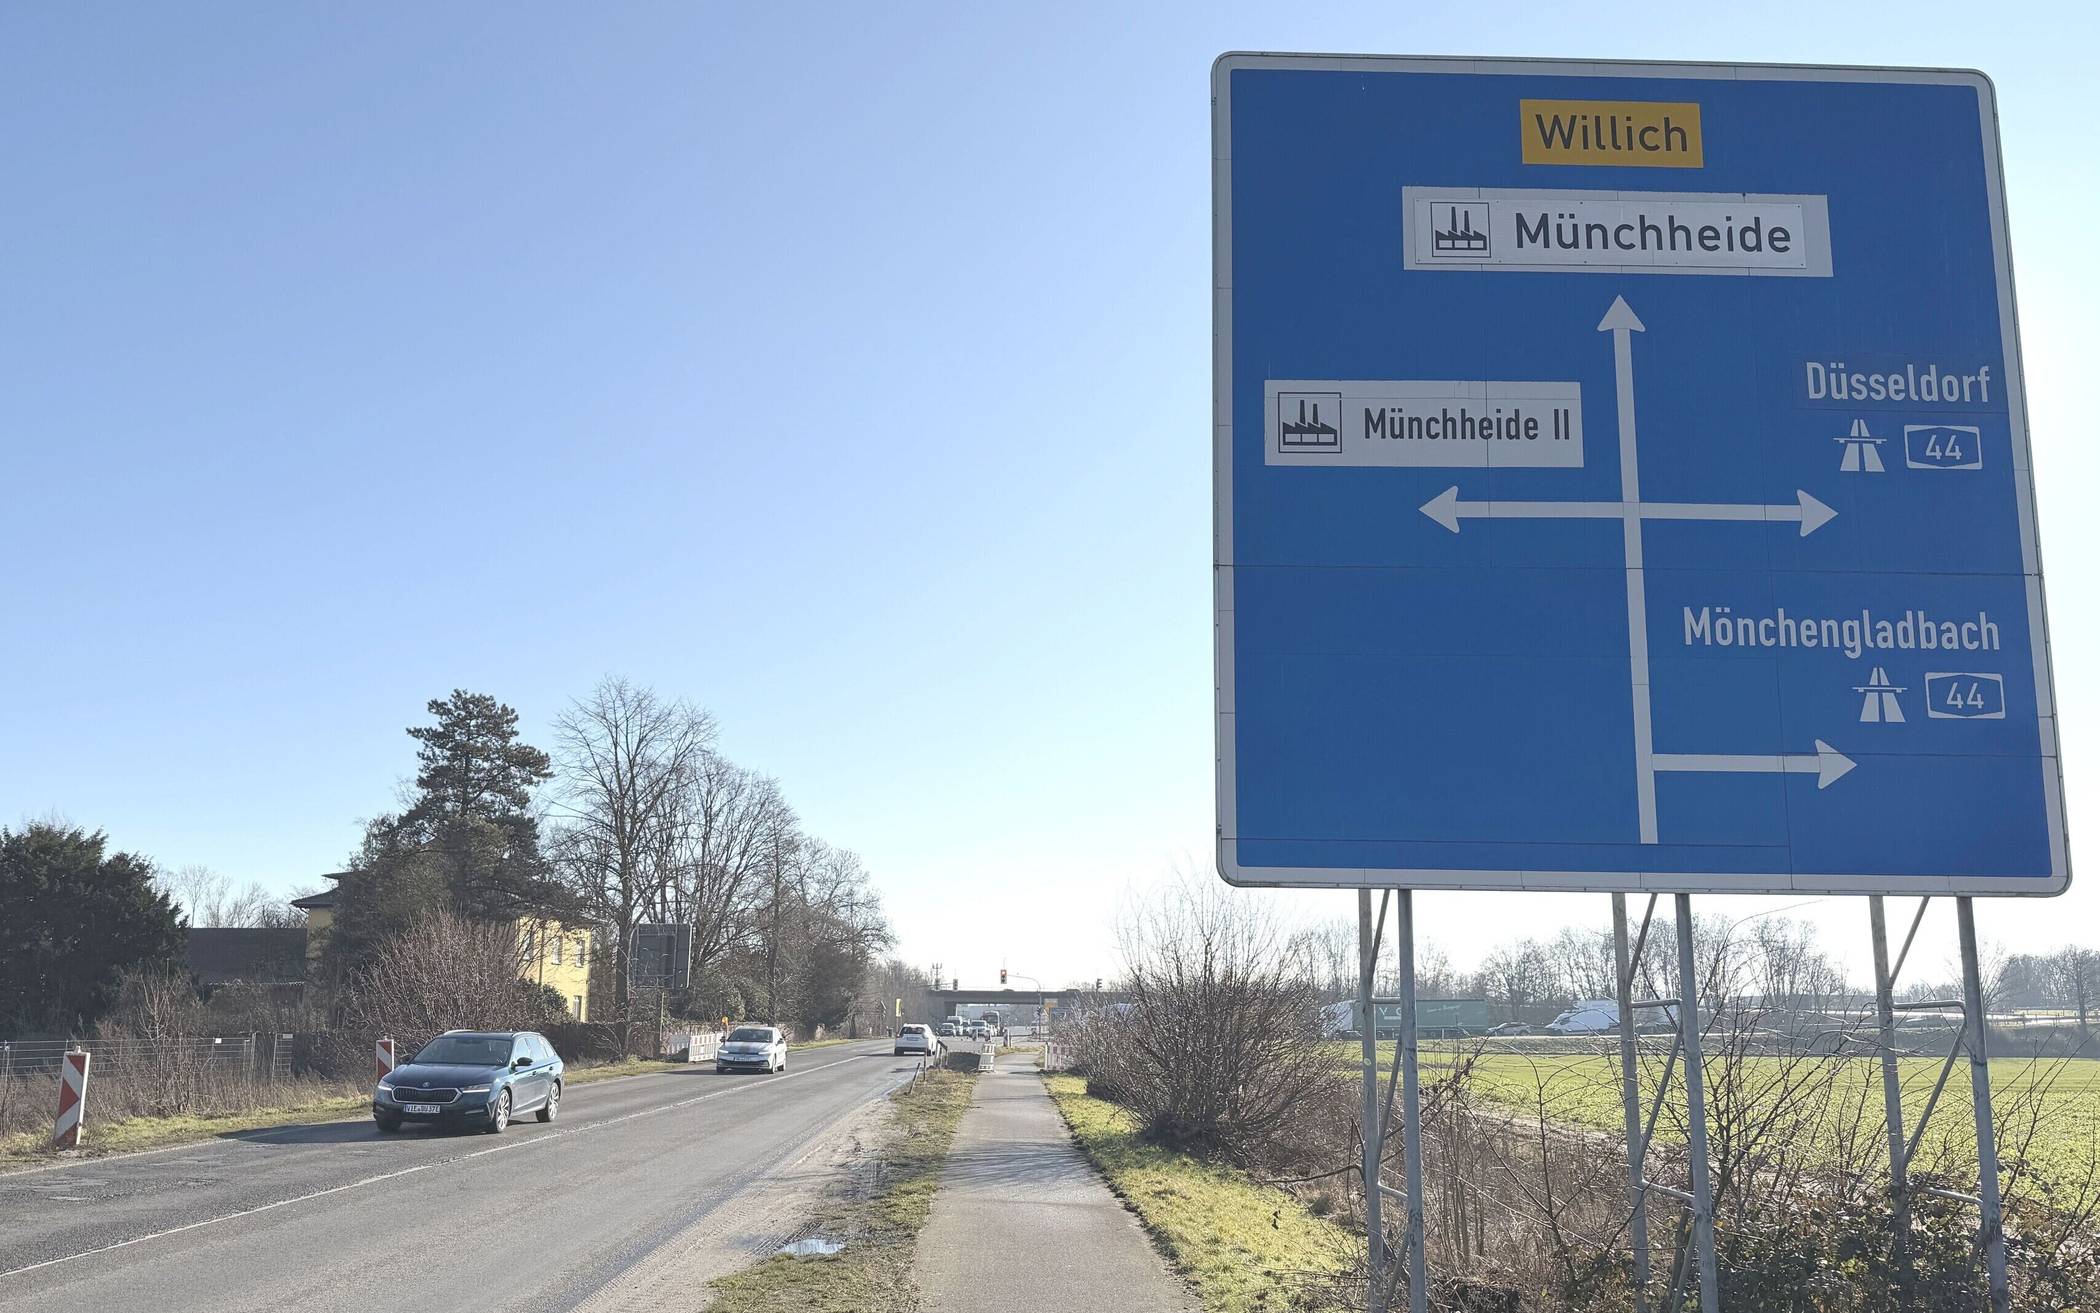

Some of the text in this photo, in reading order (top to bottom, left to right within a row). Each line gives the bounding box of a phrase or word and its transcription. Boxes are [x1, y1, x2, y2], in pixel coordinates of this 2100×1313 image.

[1535, 113, 1688, 152] Willich
[1515, 212, 1791, 253] Münchheide
[1806, 361, 1991, 403] Düsseldorf
[1364, 407, 1570, 441] Münchheide II
[1925, 434, 1962, 460] 44
[1683, 606, 2000, 659] Mönchengladbach
[1946, 682, 1985, 709] 44
